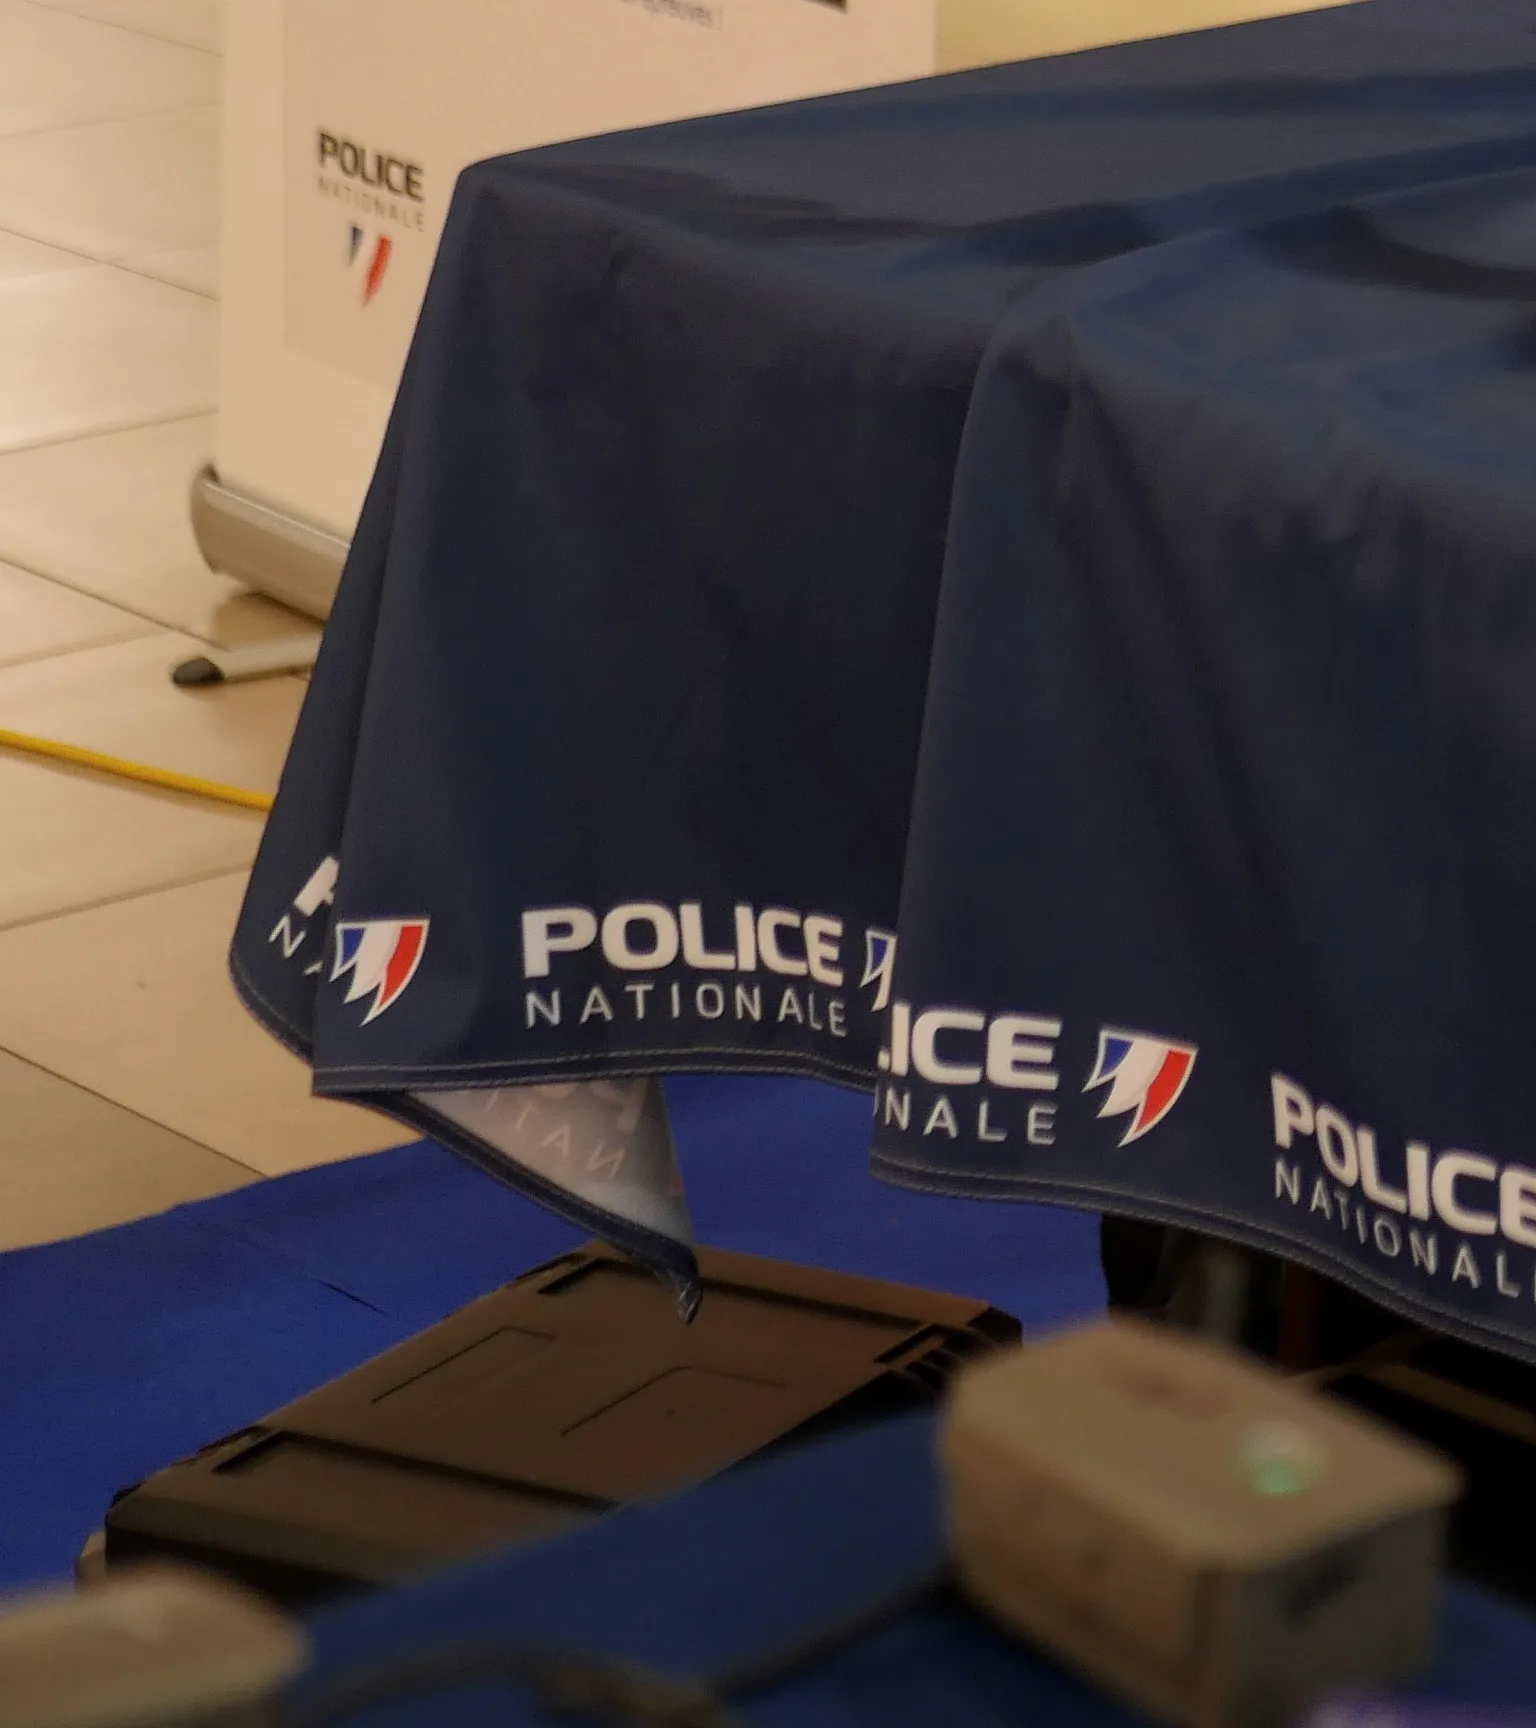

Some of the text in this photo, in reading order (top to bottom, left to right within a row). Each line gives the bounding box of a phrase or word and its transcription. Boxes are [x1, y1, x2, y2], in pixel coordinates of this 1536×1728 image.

[316, 130, 425, 203] POLICE
[521, 901, 845, 988] POLICE
[524, 979, 848, 1039] NATIONALE
[877, 1000, 1064, 1091] ICE
[873, 1083, 1059, 1147] NALE
